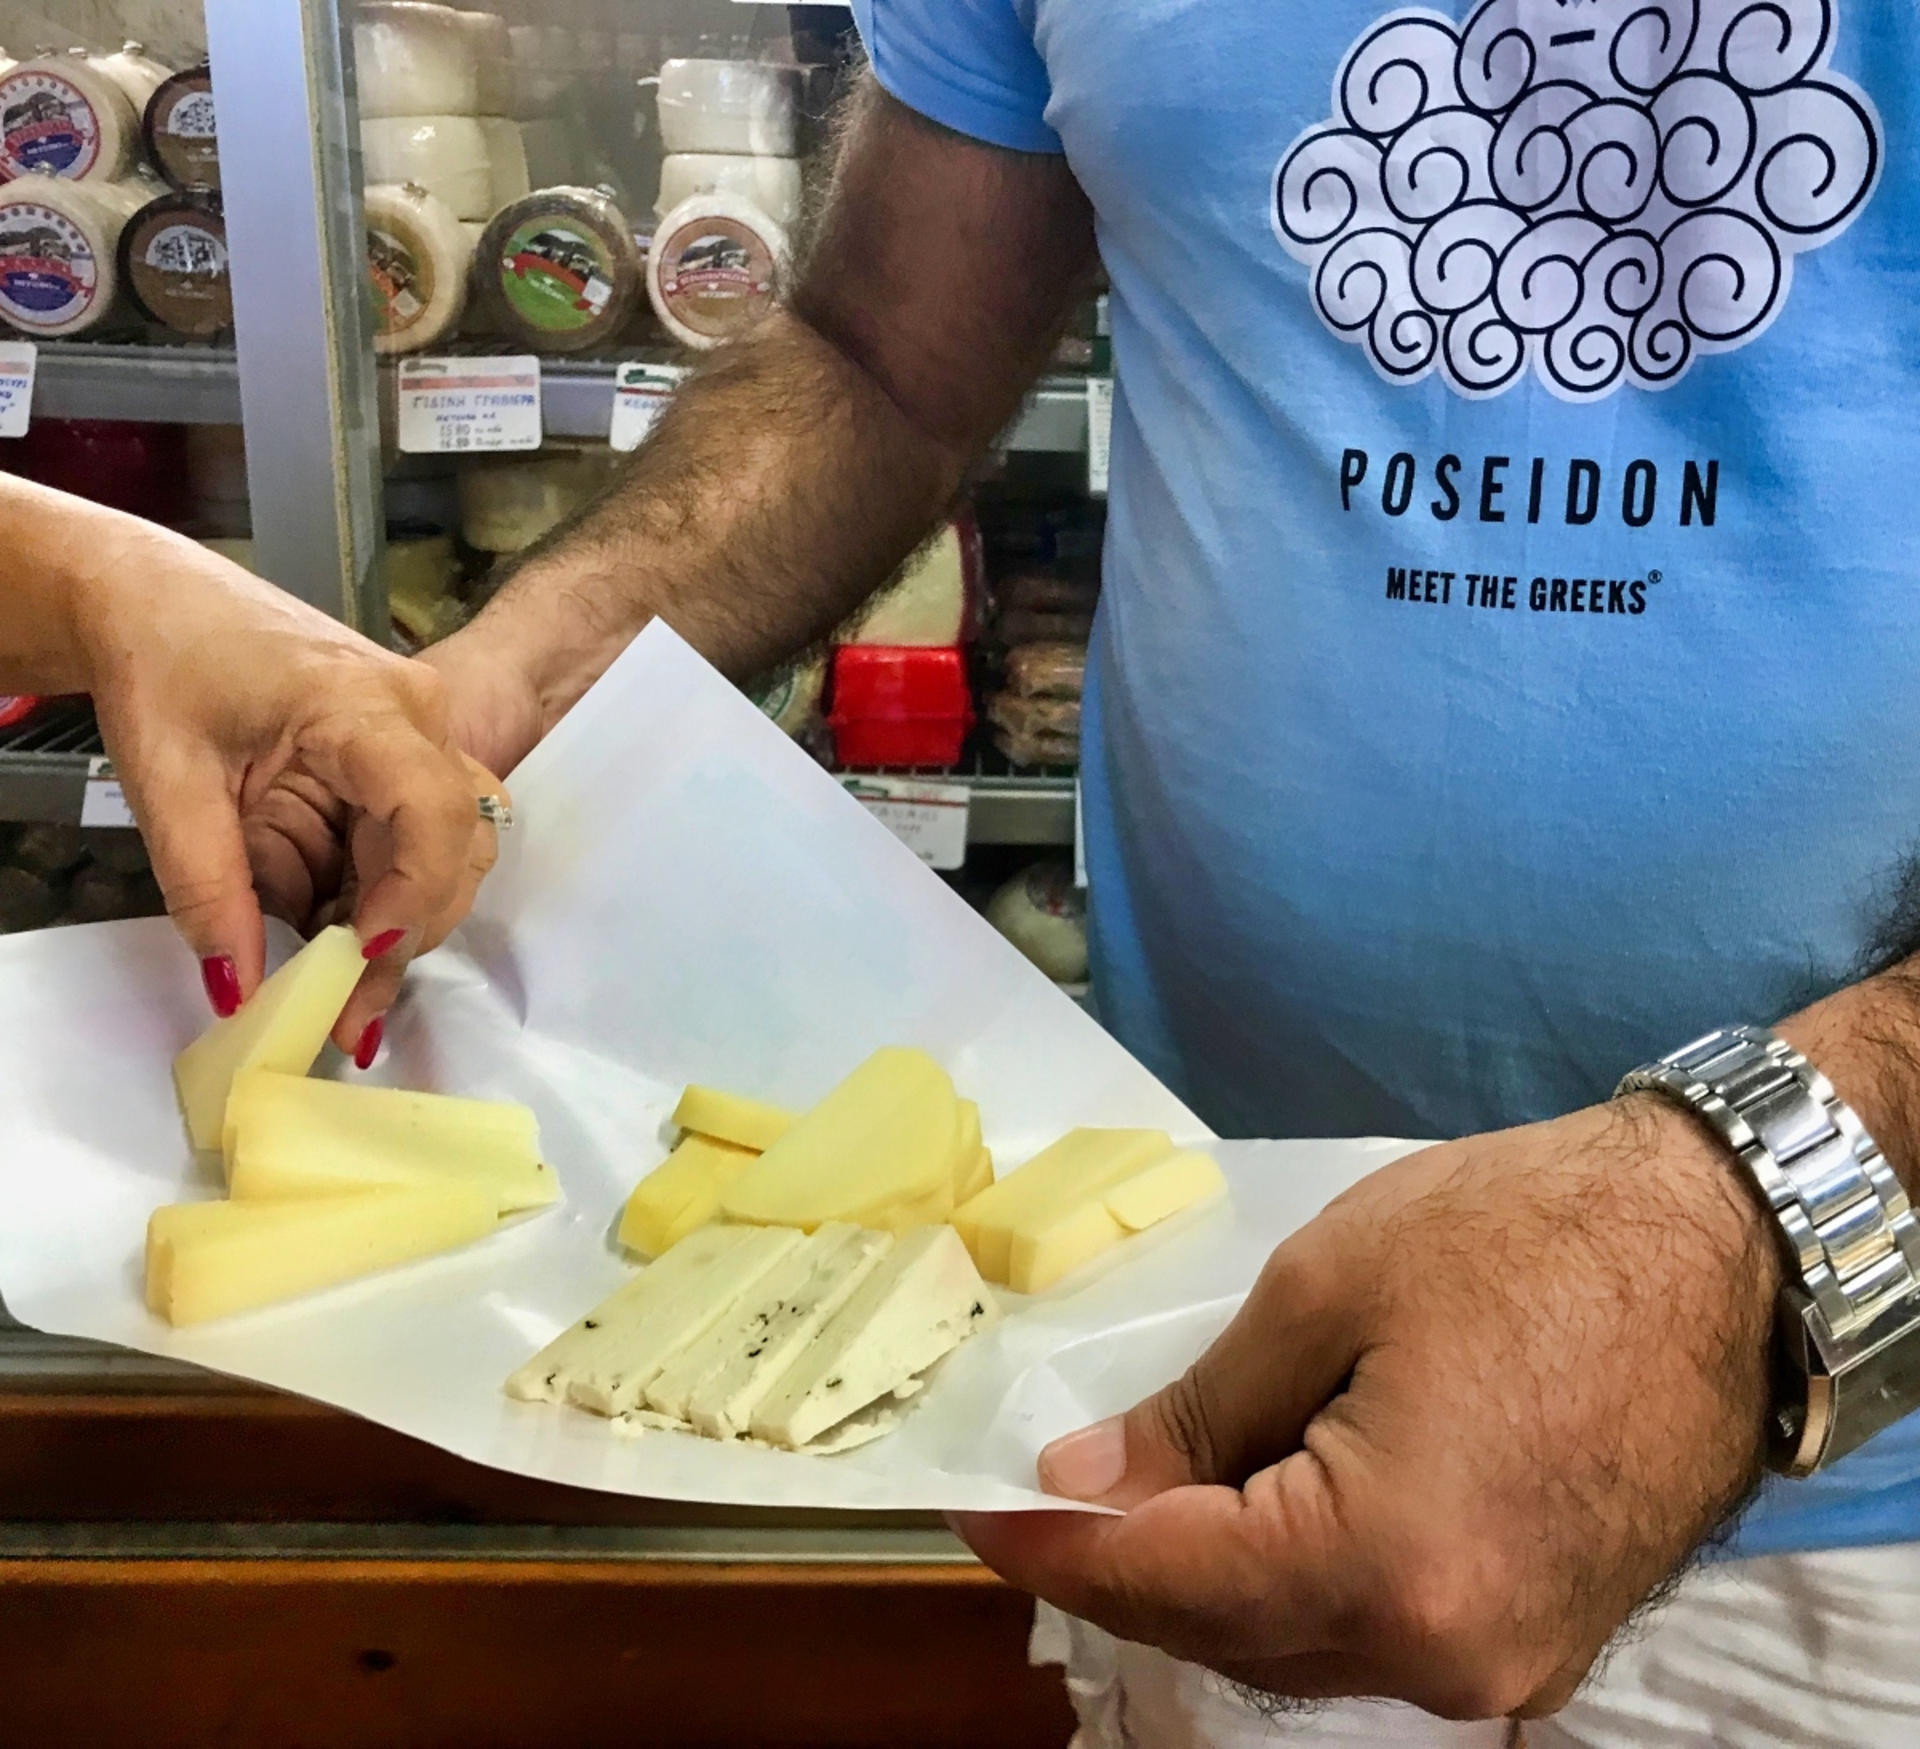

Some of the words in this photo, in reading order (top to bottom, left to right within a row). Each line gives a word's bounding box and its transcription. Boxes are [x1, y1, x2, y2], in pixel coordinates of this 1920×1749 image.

[1340, 448, 1719, 527] POSEIDON
[1386, 566, 1455, 604] MEET
[1465, 573, 1517, 609] THE
